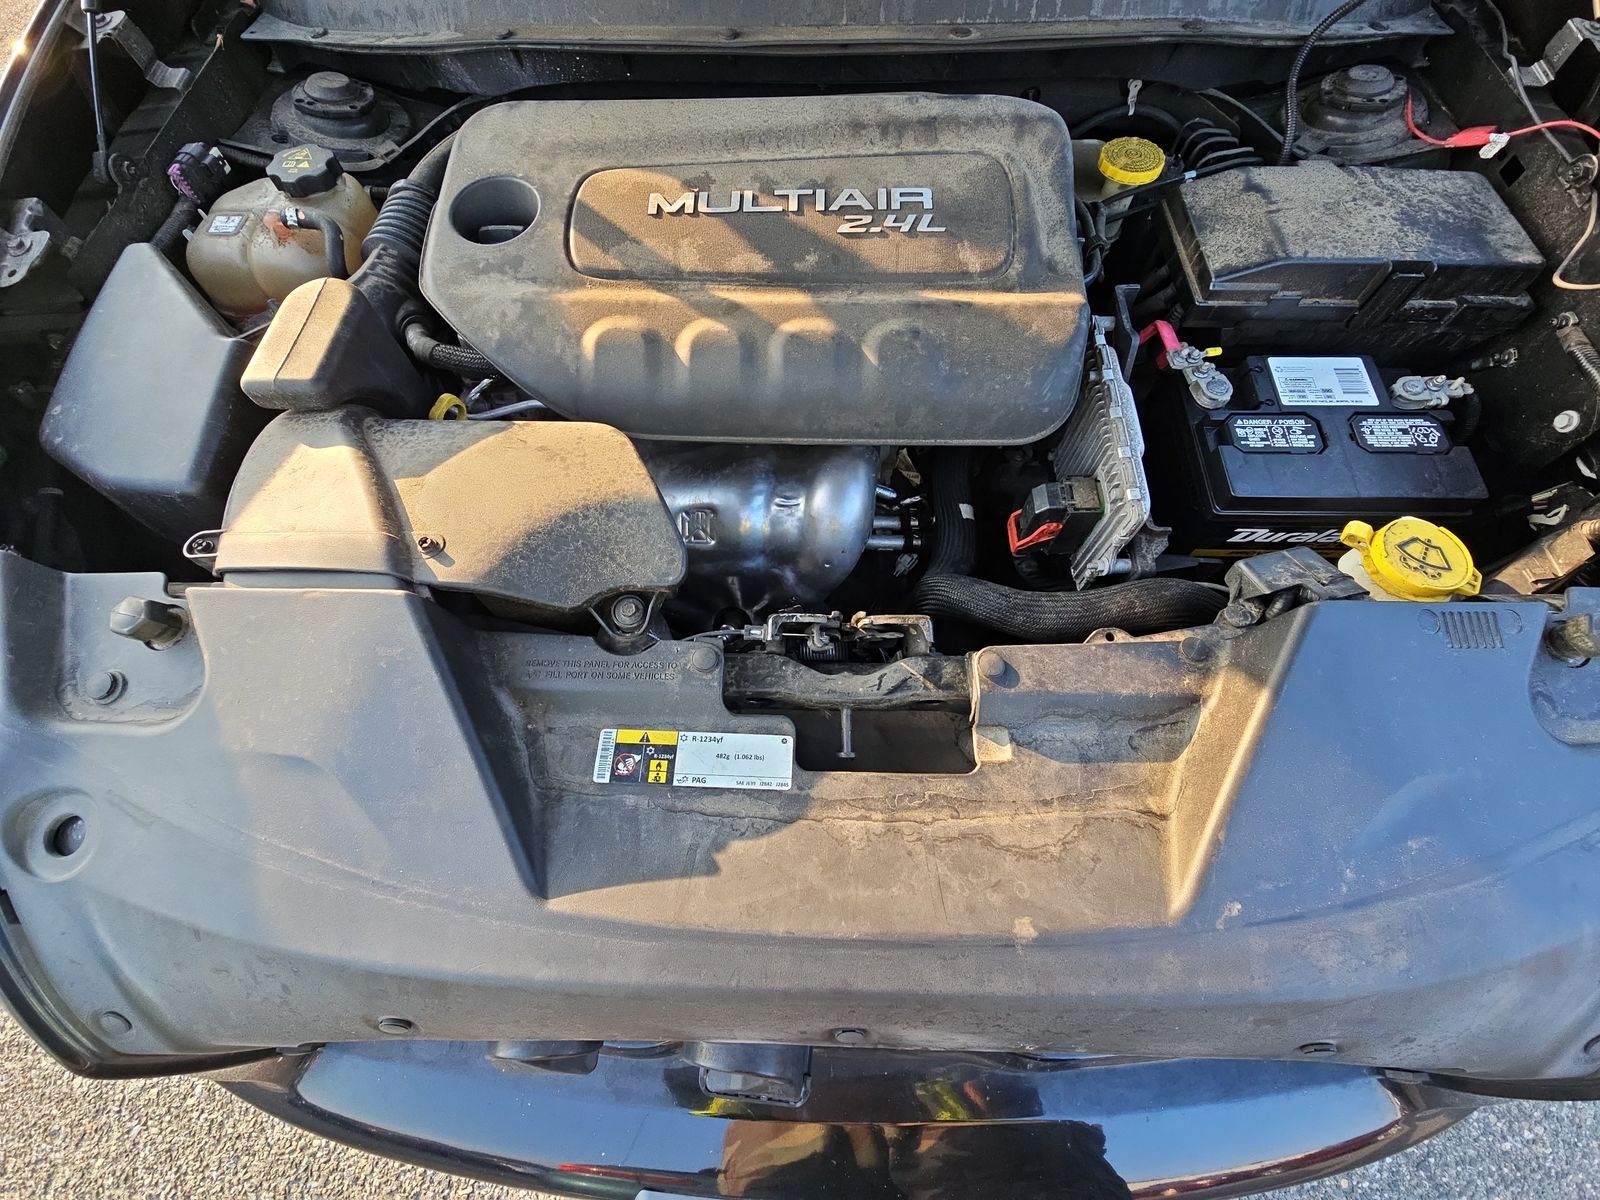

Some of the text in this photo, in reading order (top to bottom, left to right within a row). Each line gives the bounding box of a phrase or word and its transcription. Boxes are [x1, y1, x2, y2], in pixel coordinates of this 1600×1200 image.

[648, 187, 934, 215] MULTIAIR
[836, 214, 947, 233] 2.4L
[1226, 528, 1342, 543] Durala
[526, 659, 561, 668] REMOVE
[563, 660, 582, 668] THIS
[584, 660, 610, 669] PANEL
[612, 661, 630, 669] FOR
[631, 661, 664, 670] ACCESS
[566, 671, 588, 680] PORT
[590, 672, 604, 680] ON
[606, 672, 631, 680] SOME
[633, 672, 675, 681] VEHICLES
[692, 735, 724, 743] R-1234yf
[734, 753, 752, 761] (1.062
